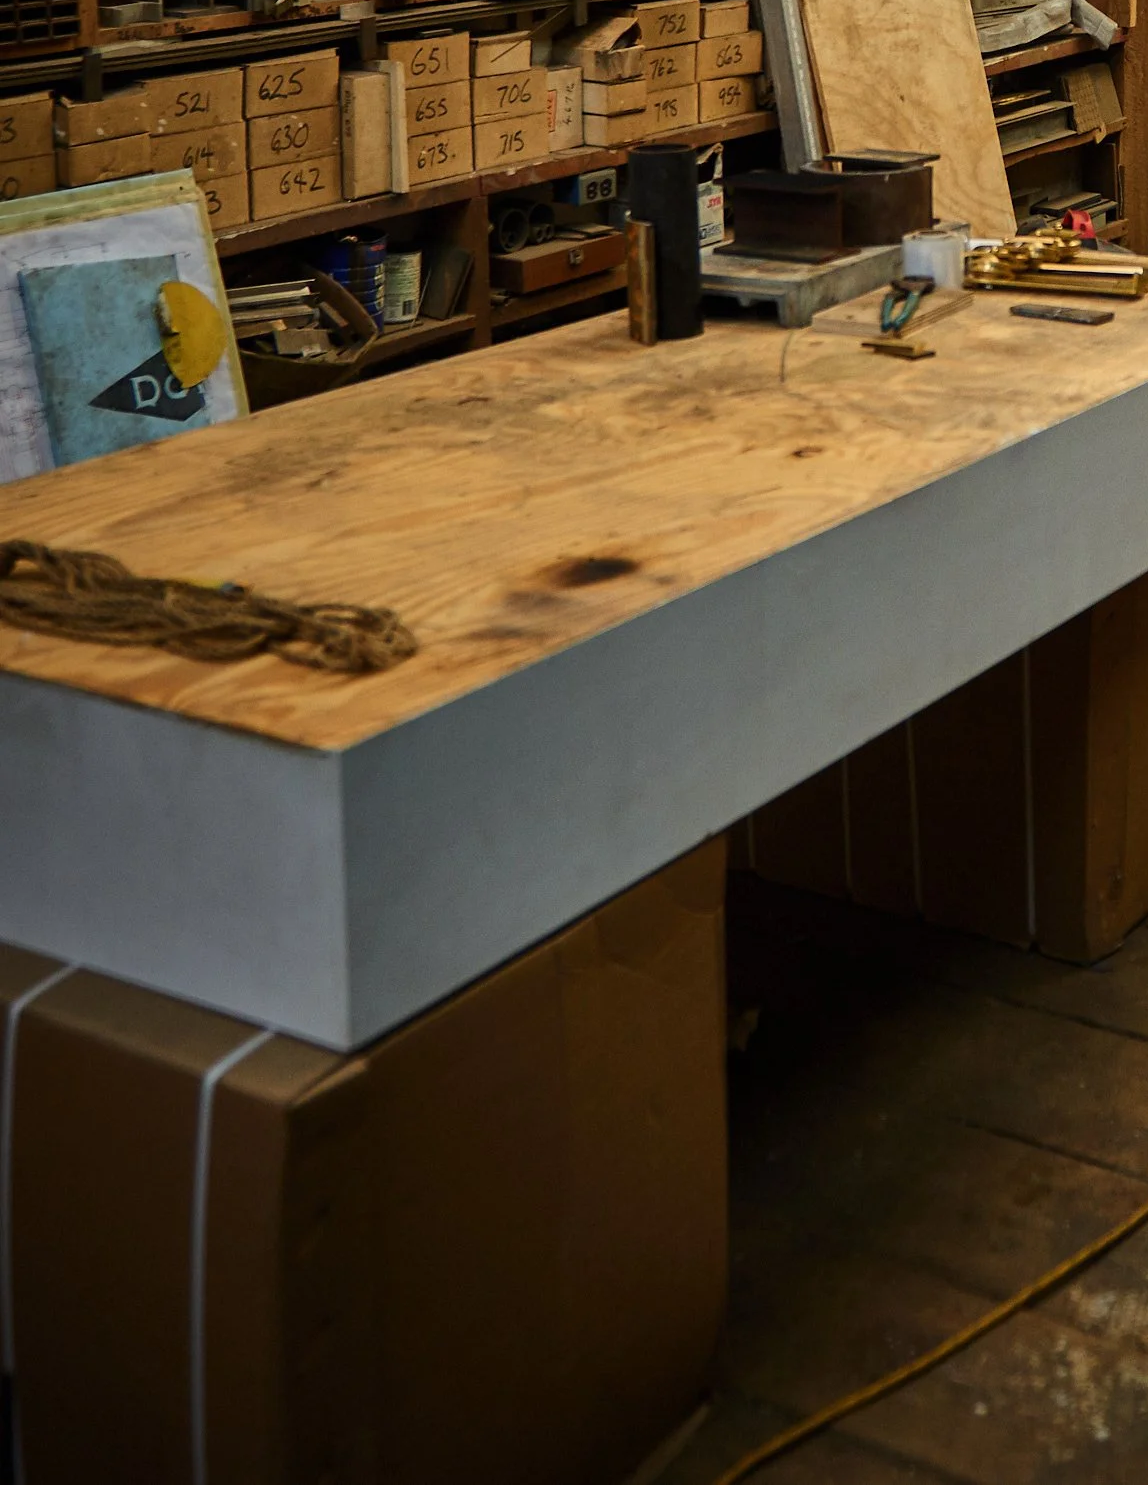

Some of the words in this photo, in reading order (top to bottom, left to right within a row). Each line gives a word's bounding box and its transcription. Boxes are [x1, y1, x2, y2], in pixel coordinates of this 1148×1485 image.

[658, 13, 686, 35] 752
[410, 47, 449, 75] 651
[649, 58, 679, 80] 762
[258, 68, 305, 101] 625
[497, 78, 532, 107] 706
[174, 91, 209, 117] 521
[414, 96, 448, 121] 655
[655, 98, 678, 122] 798
[271, 123, 309, 152] 630
[500, 130, 525, 156] 715
[182, 145, 214, 168] 614
[279, 167, 326, 195] 642
[586, 178, 613, 200] 88
